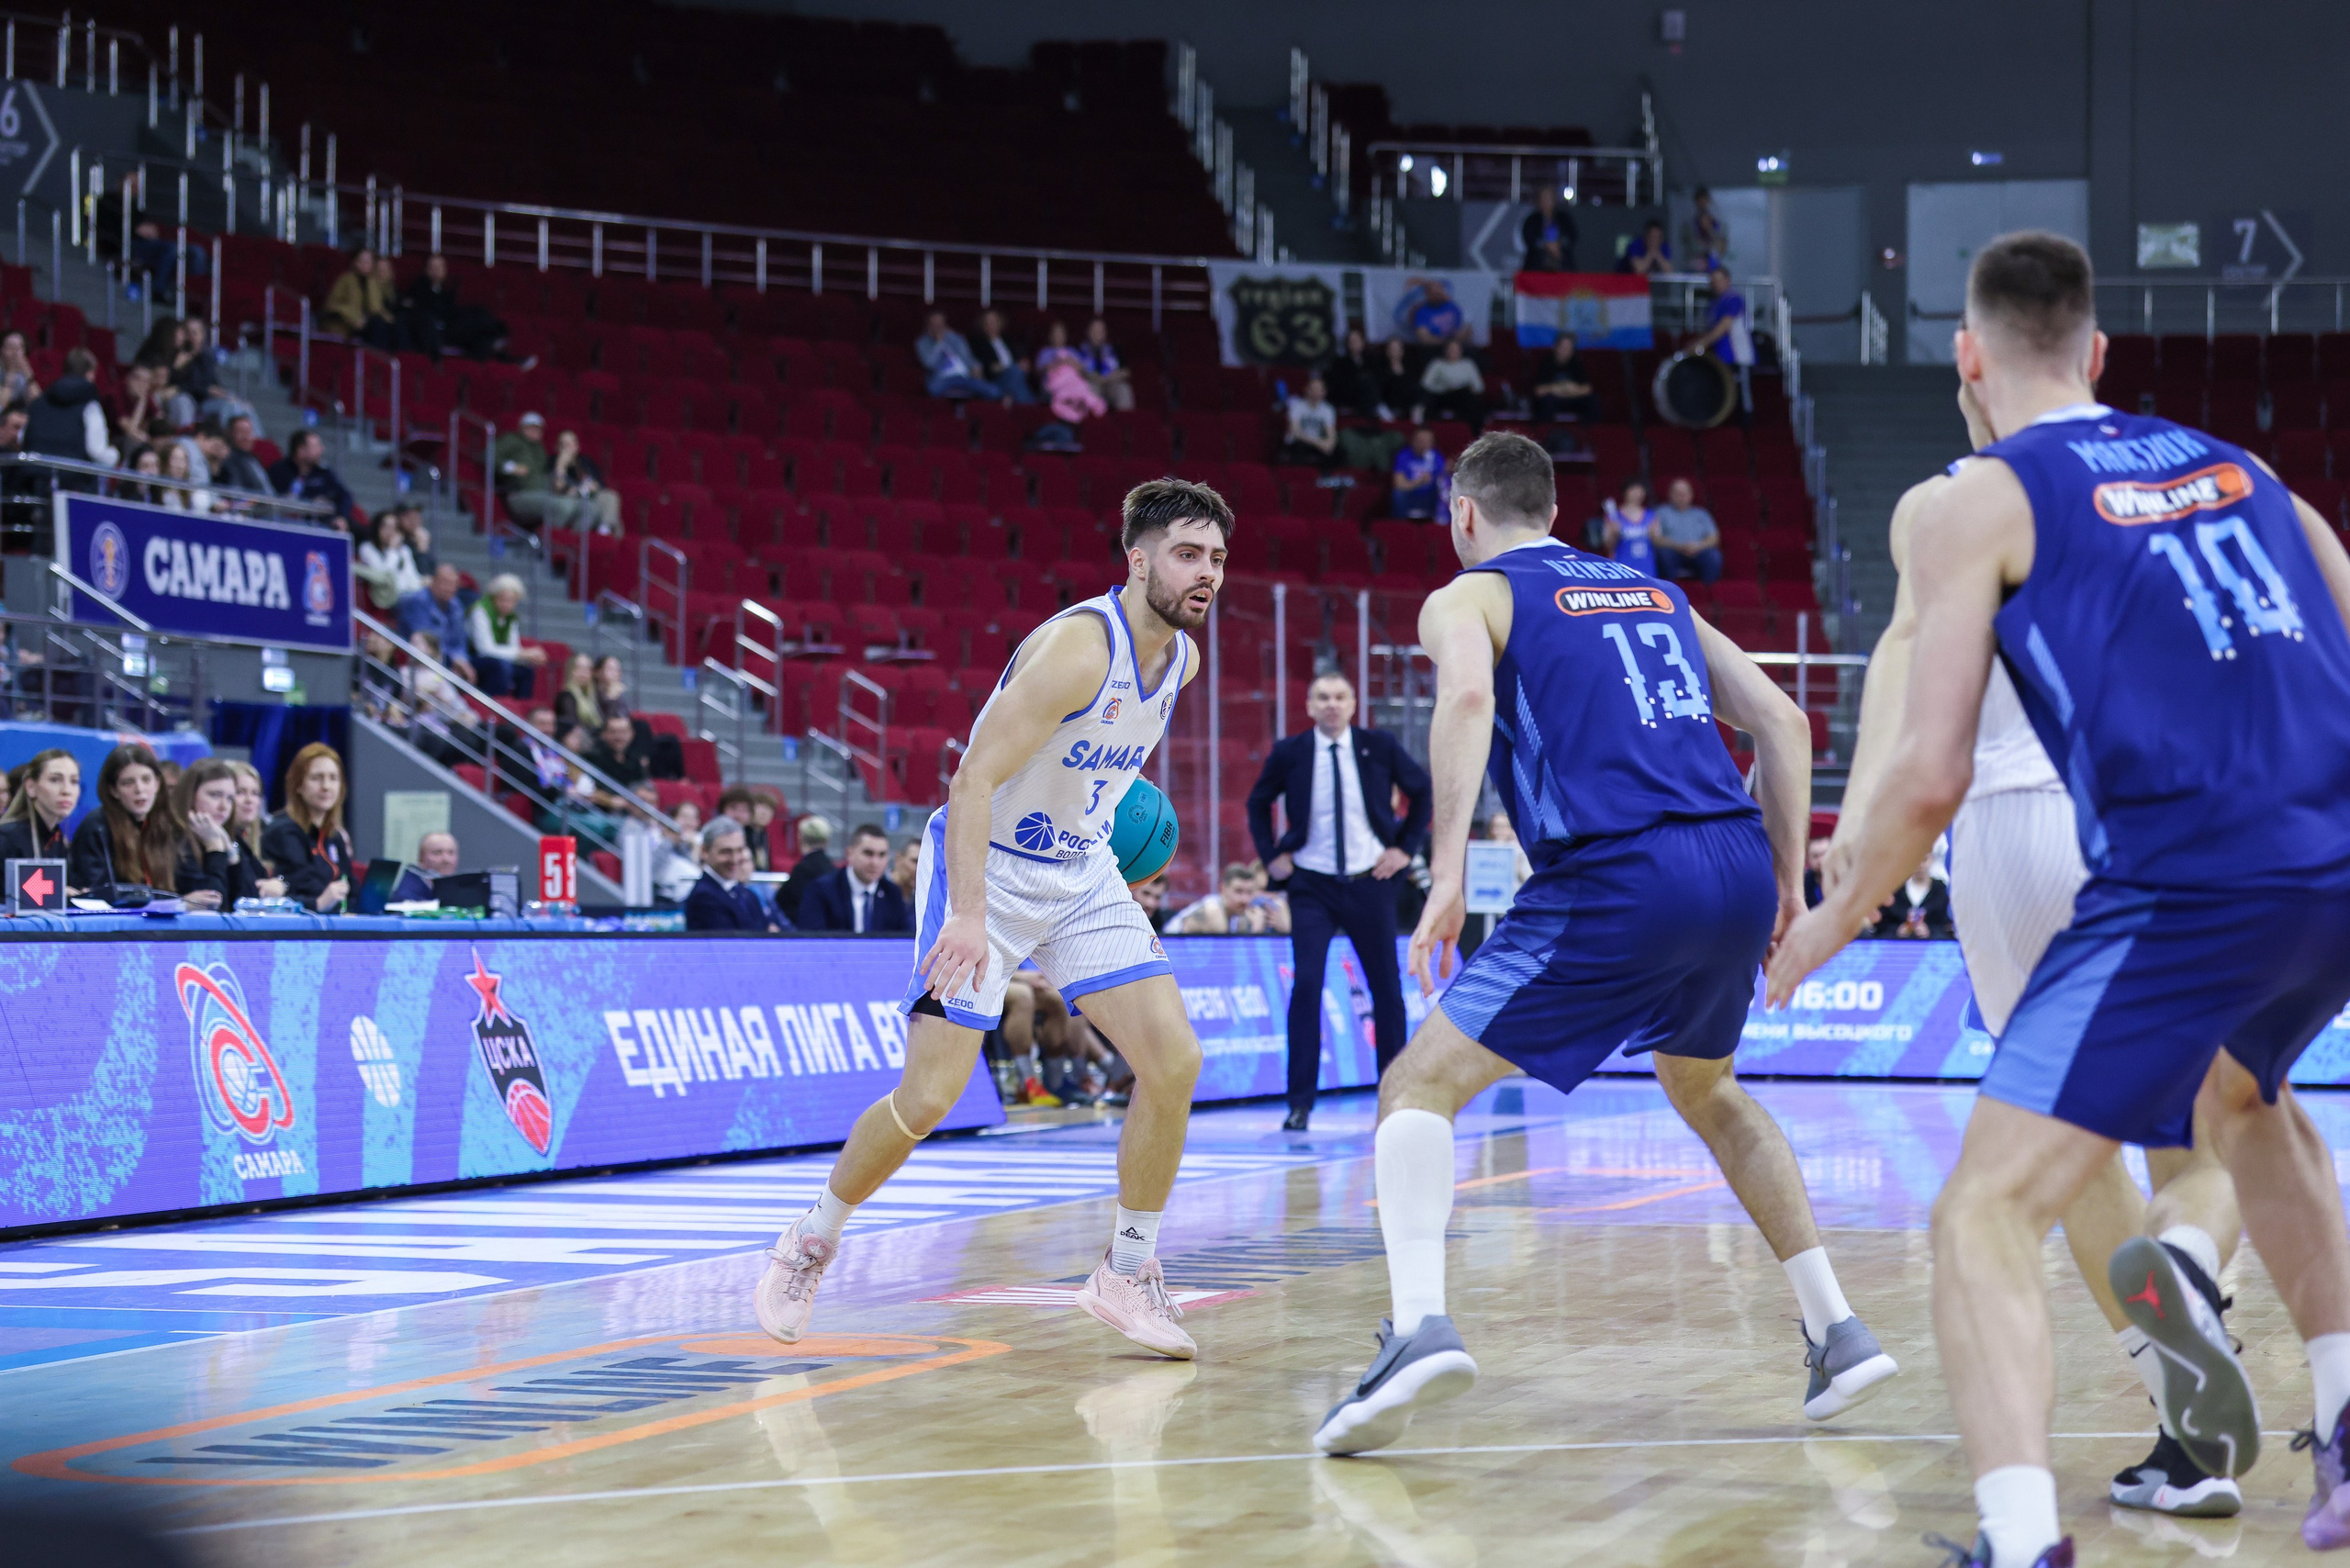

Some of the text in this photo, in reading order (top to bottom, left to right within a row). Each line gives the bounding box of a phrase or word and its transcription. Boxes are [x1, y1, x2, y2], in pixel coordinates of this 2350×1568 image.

[0, 86, 20, 137] 6
[2232, 218, 2256, 263] 7
[1250, 312, 1328, 356] 63
[143, 535, 292, 610] САМАРА
[2149, 515, 2304, 661] 10
[1564, 591, 1653, 610] WINLINE
[1602, 622, 1712, 727] 13
[1062, 739, 1145, 772] SAMAR
[1085, 779, 1108, 815] 3
[1160, 820, 1173, 846] FIBA
[544, 852, 563, 899] 5
[948, 997, 974, 1010] ZEDO
[482, 1035, 538, 1076] ЦСКА
[604, 1006, 785, 1099] ЕДИНАЯ
[775, 1002, 881, 1076] ЛИГА
[233, 1149, 307, 1181] САМАРА
[134, 1356, 834, 1468] WINLINE
